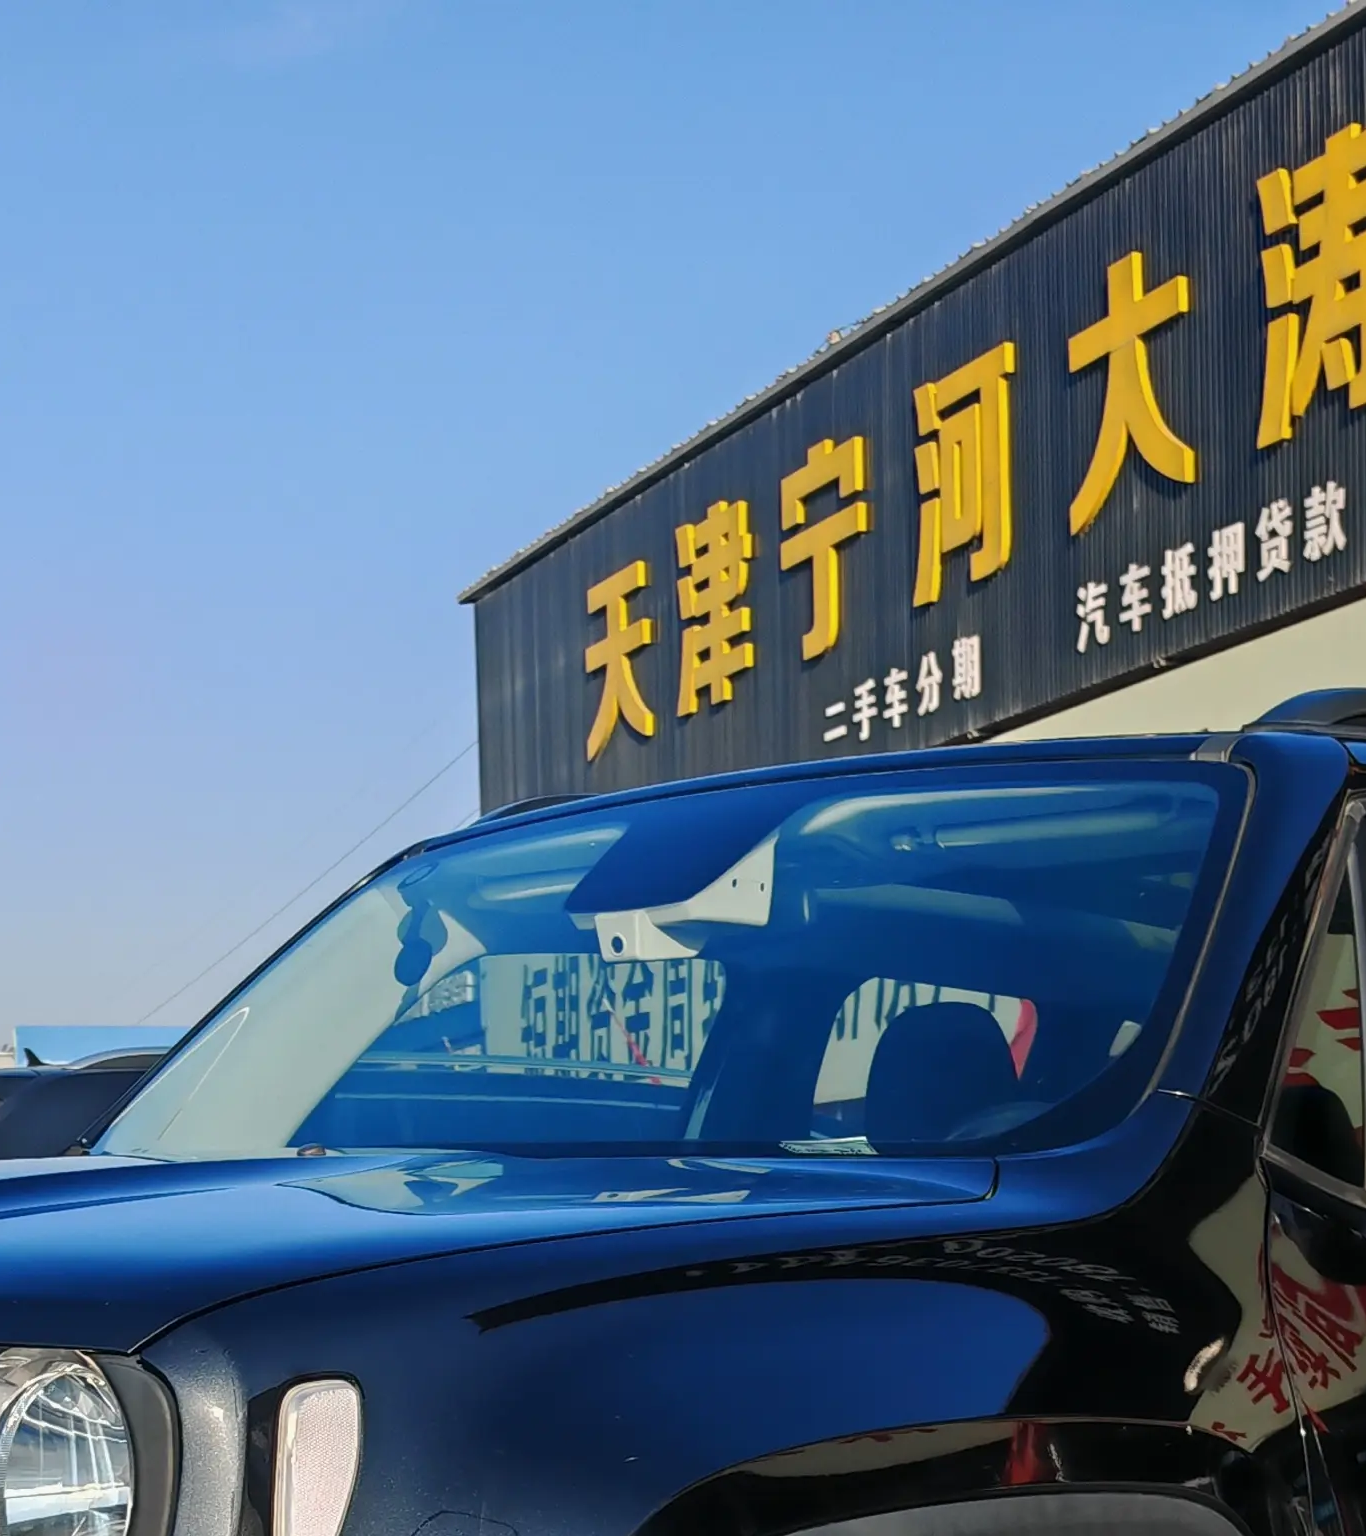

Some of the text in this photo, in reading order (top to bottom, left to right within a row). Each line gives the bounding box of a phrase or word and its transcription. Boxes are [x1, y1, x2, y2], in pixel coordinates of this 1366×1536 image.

[1076, 480, 1348, 655] 汽车抵押贷款
[822, 634, 982, 742] 二手车分期
